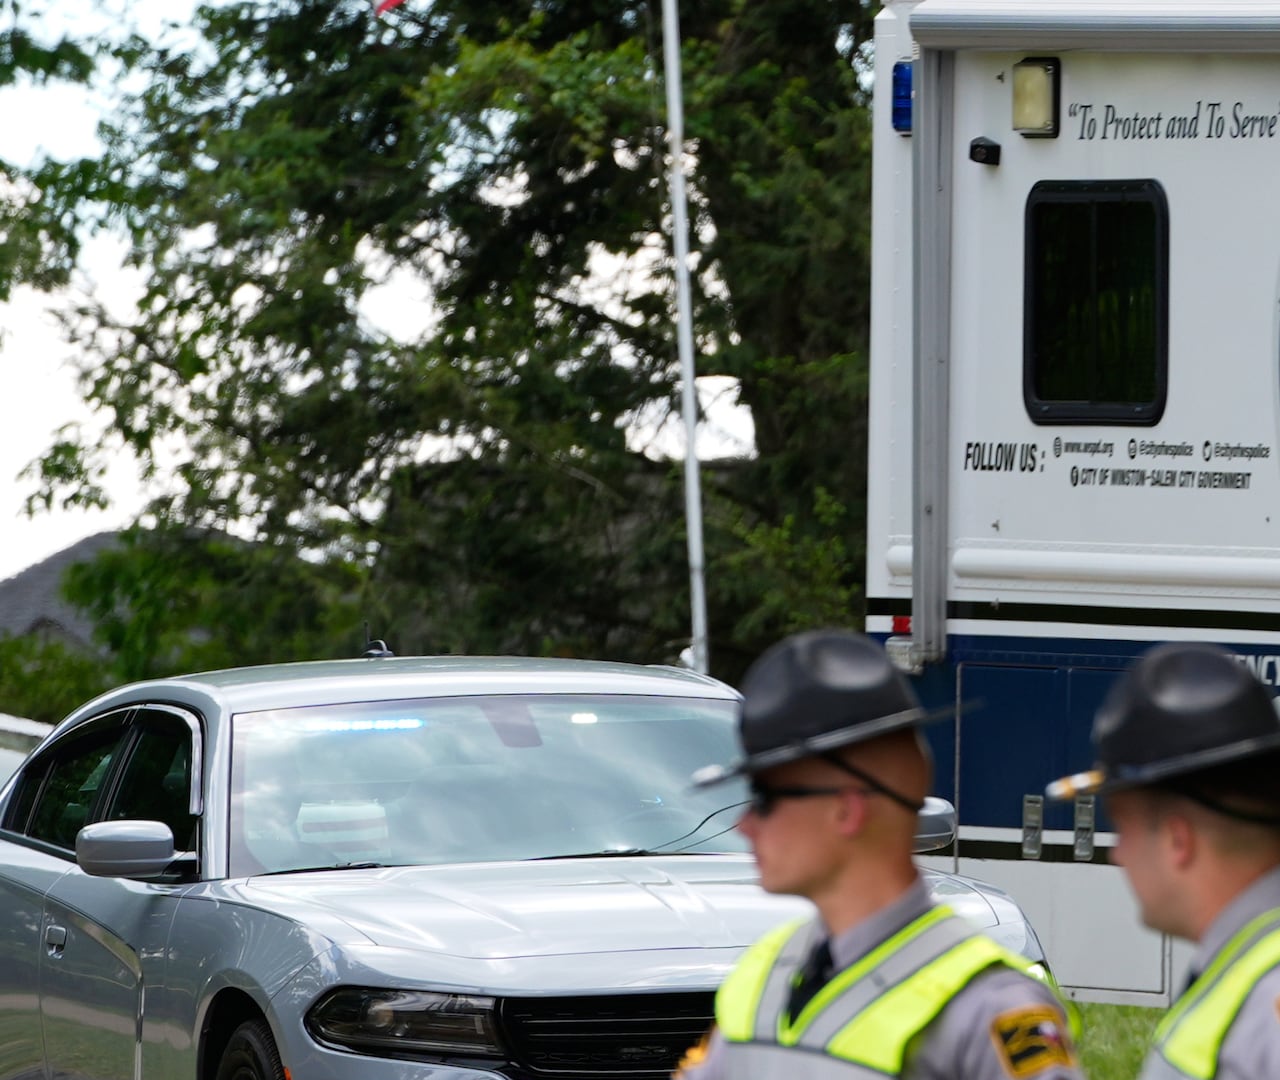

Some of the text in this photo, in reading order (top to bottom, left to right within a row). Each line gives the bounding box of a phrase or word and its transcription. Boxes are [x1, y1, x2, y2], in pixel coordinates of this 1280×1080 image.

[1101, 104, 1162, 140] Protect
[1165, 101, 1201, 139] and
[1206, 102, 1225, 139] To
[964, 442, 1014, 471] FOLLOW
[1019, 443, 1037, 472] US
[1081, 468, 1252, 489] CITY OF WINSTON-SALEM CITY GOVERNMENT
